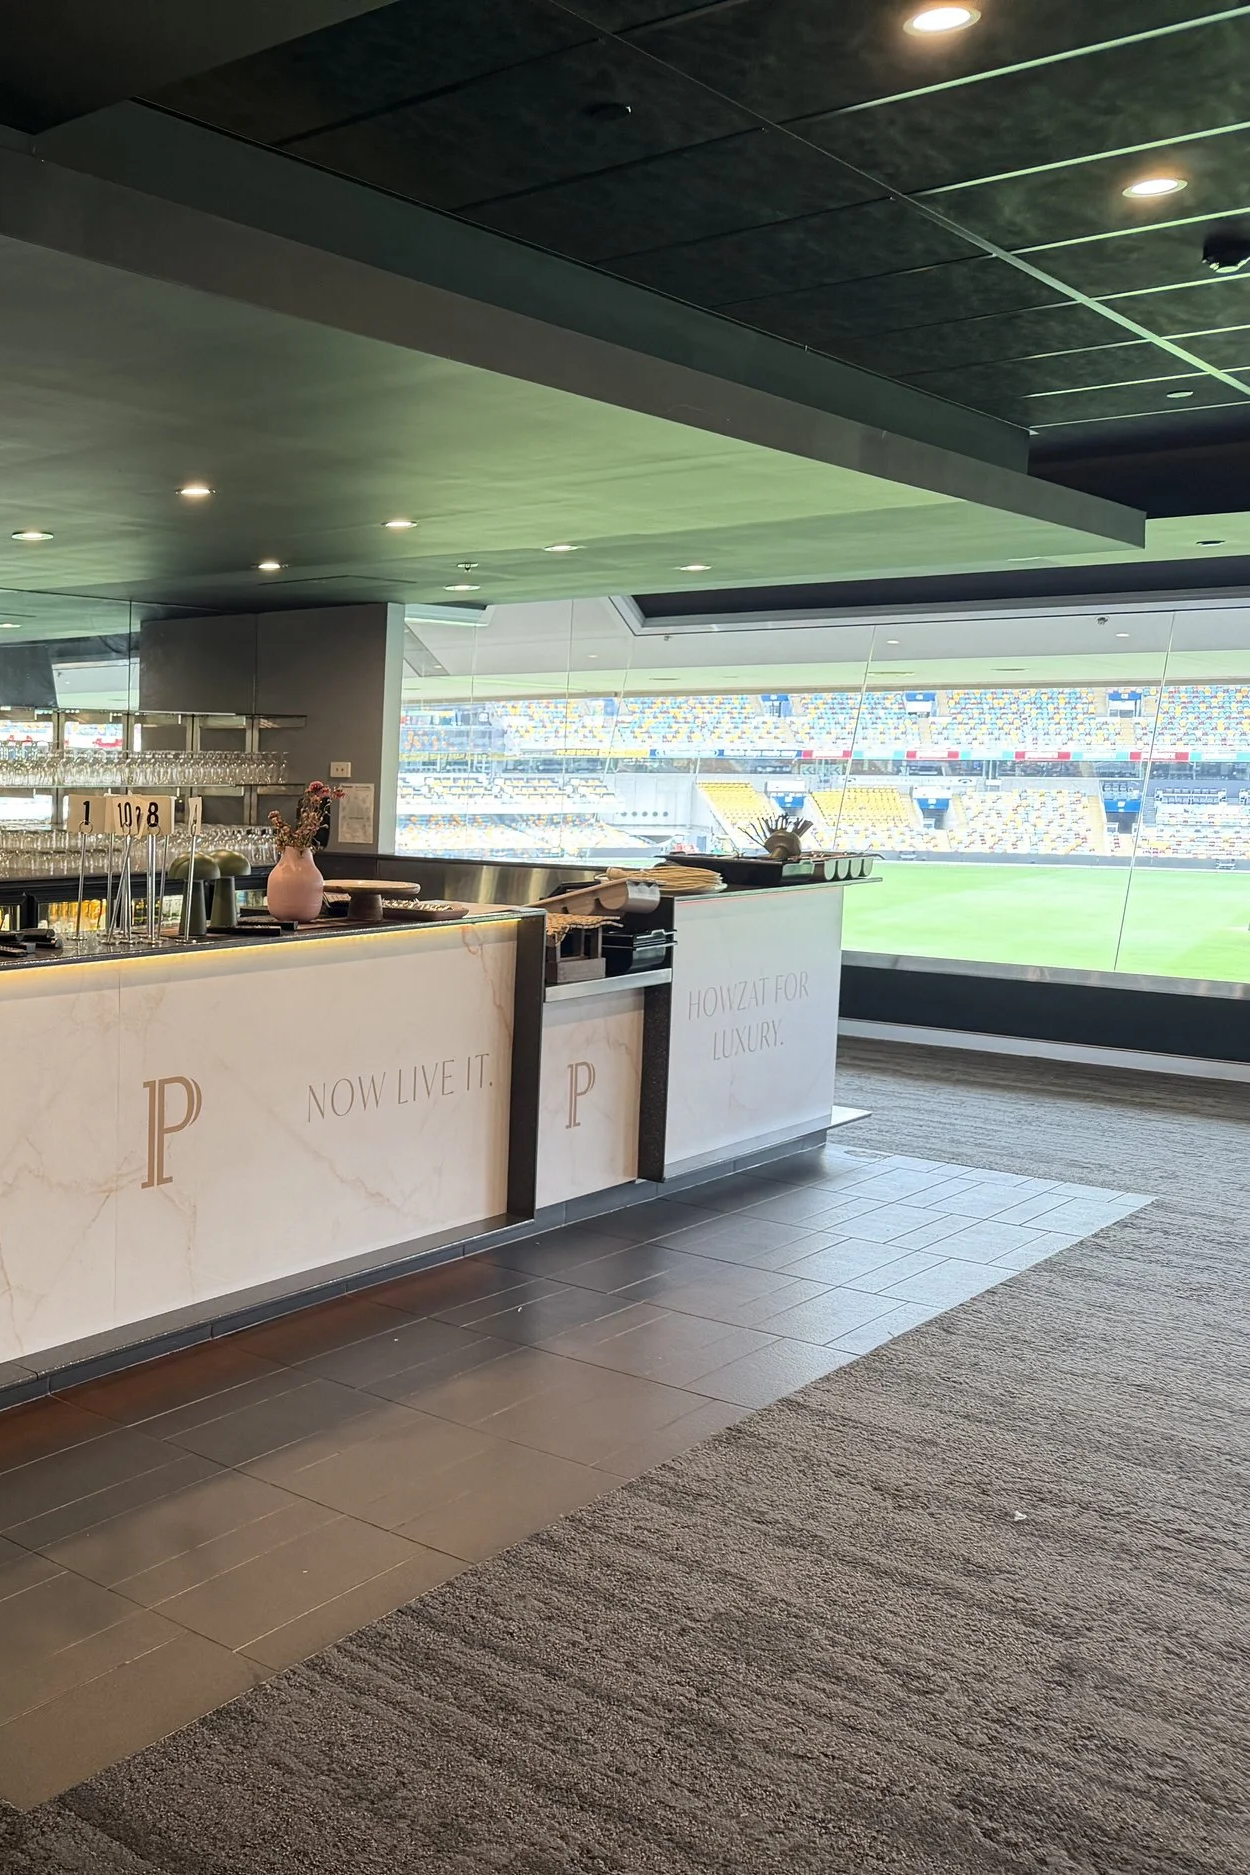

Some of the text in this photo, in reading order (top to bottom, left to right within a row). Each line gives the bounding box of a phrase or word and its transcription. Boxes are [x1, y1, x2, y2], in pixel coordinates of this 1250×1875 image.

[83, 800, 91, 826] 1
[117, 801, 133, 828] 10
[146, 801, 159, 828] 8
[688, 970, 810, 1021] HOWZAT FOR
[712, 1018, 785, 1061] LUXURY.
[307, 1053, 494, 1124] NOW LIVE IT.
[565, 1060, 597, 1130] P
[141, 1075, 203, 1191] P
